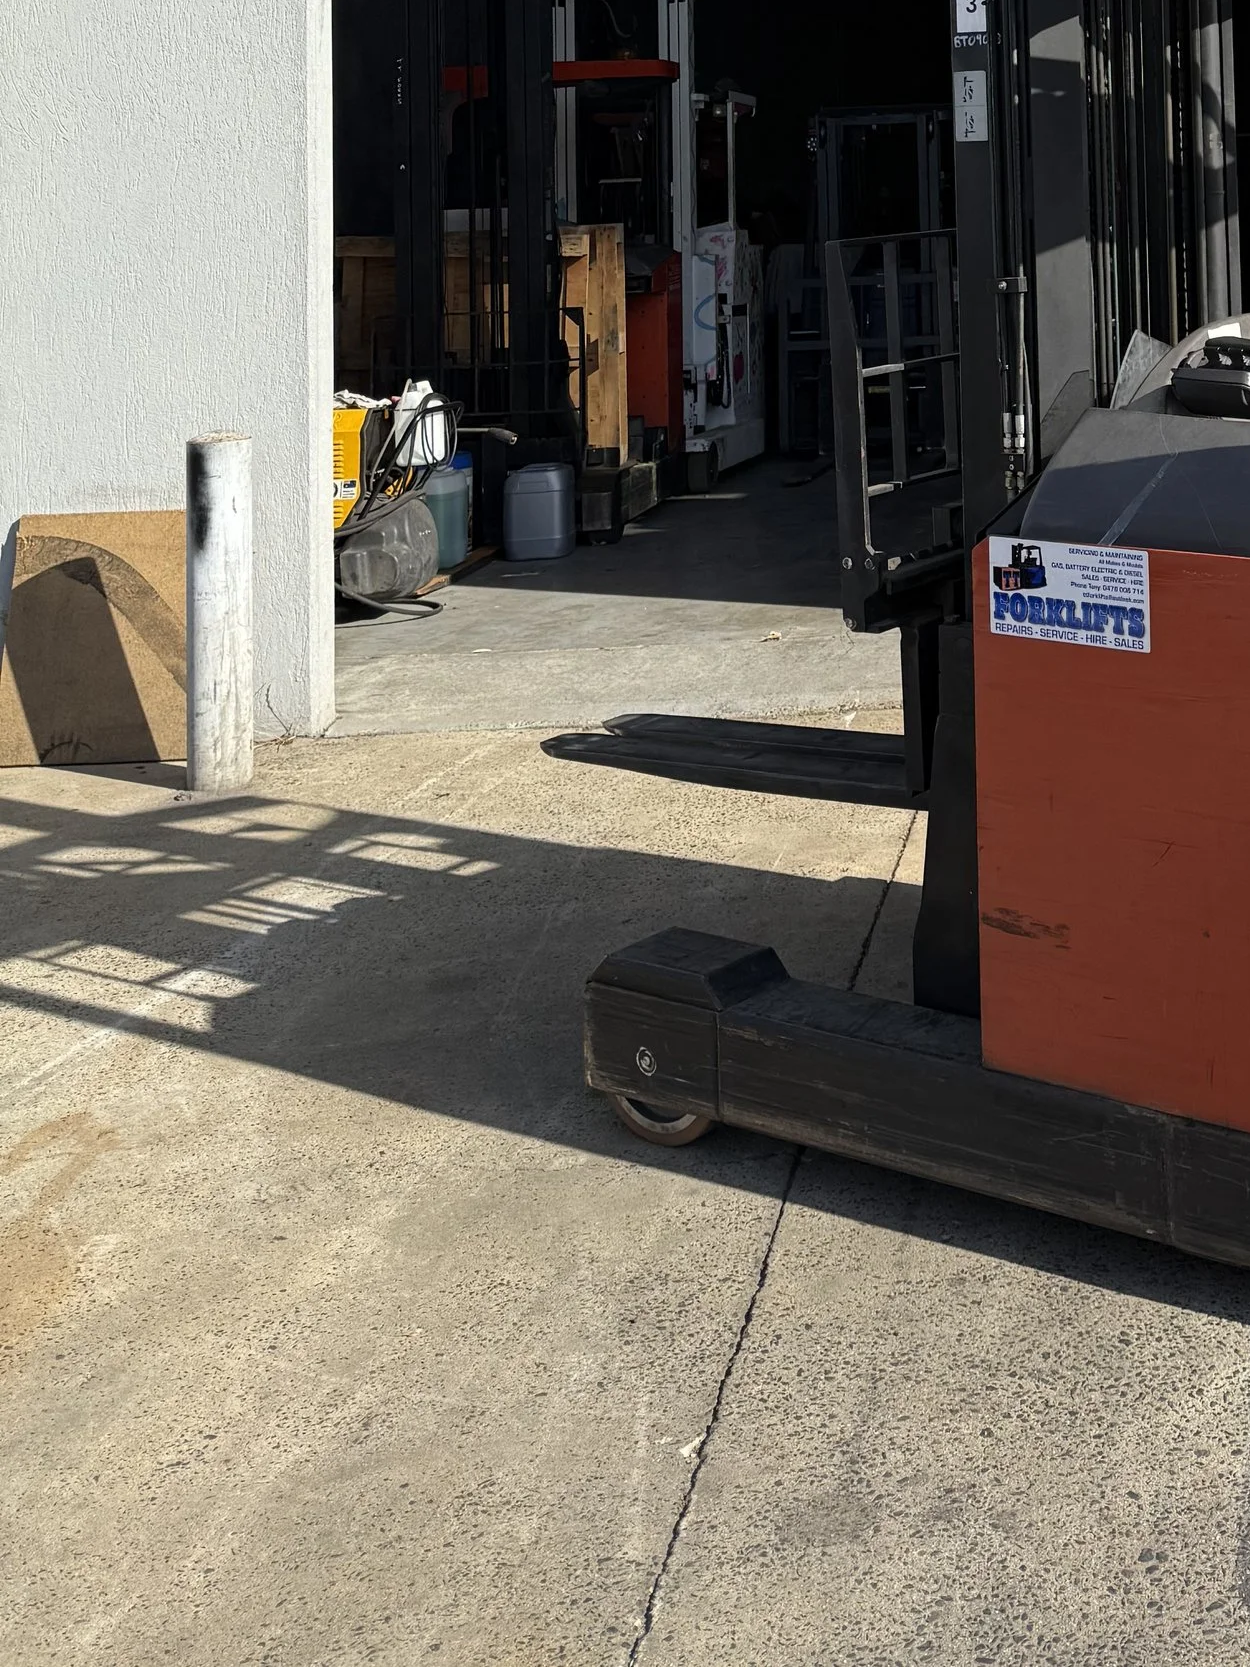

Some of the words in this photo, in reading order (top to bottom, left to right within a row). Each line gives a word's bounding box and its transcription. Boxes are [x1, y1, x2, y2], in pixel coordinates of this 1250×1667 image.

[993, 591, 1145, 638] FORKLIFTS
[995, 622, 1033, 636] REPAIRS
[1040, 629, 1078, 642] SERVICE
[1085, 635, 1107, 645] HIRE
[1114, 638, 1144, 650] SALES
